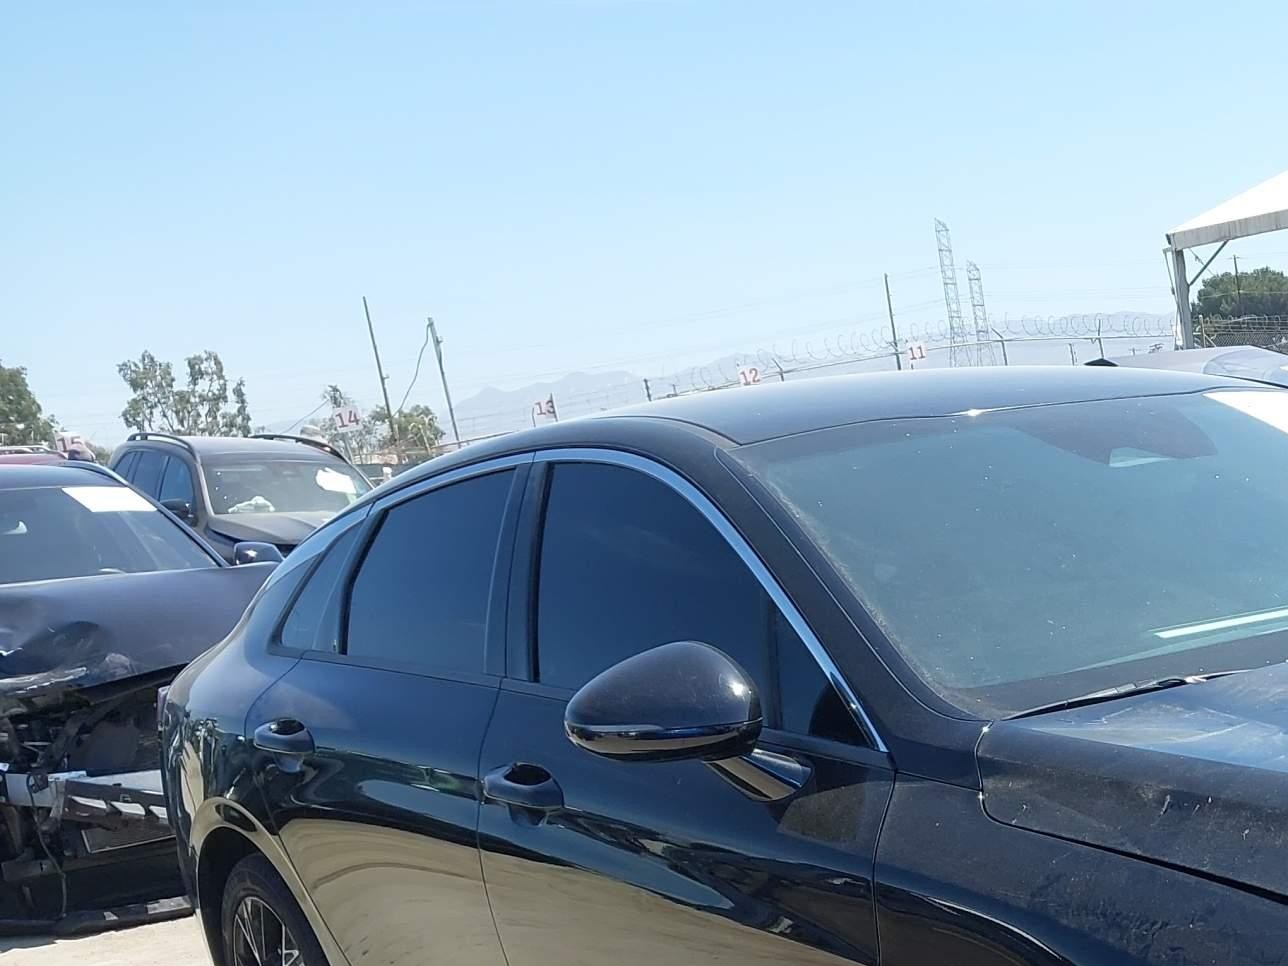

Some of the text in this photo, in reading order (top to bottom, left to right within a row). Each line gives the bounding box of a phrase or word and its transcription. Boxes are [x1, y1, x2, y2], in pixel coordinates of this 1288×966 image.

[908, 345, 926, 360] 11
[740, 367, 760, 386] 12
[535, 400, 555, 415] 13
[335, 410, 360, 428] 14
